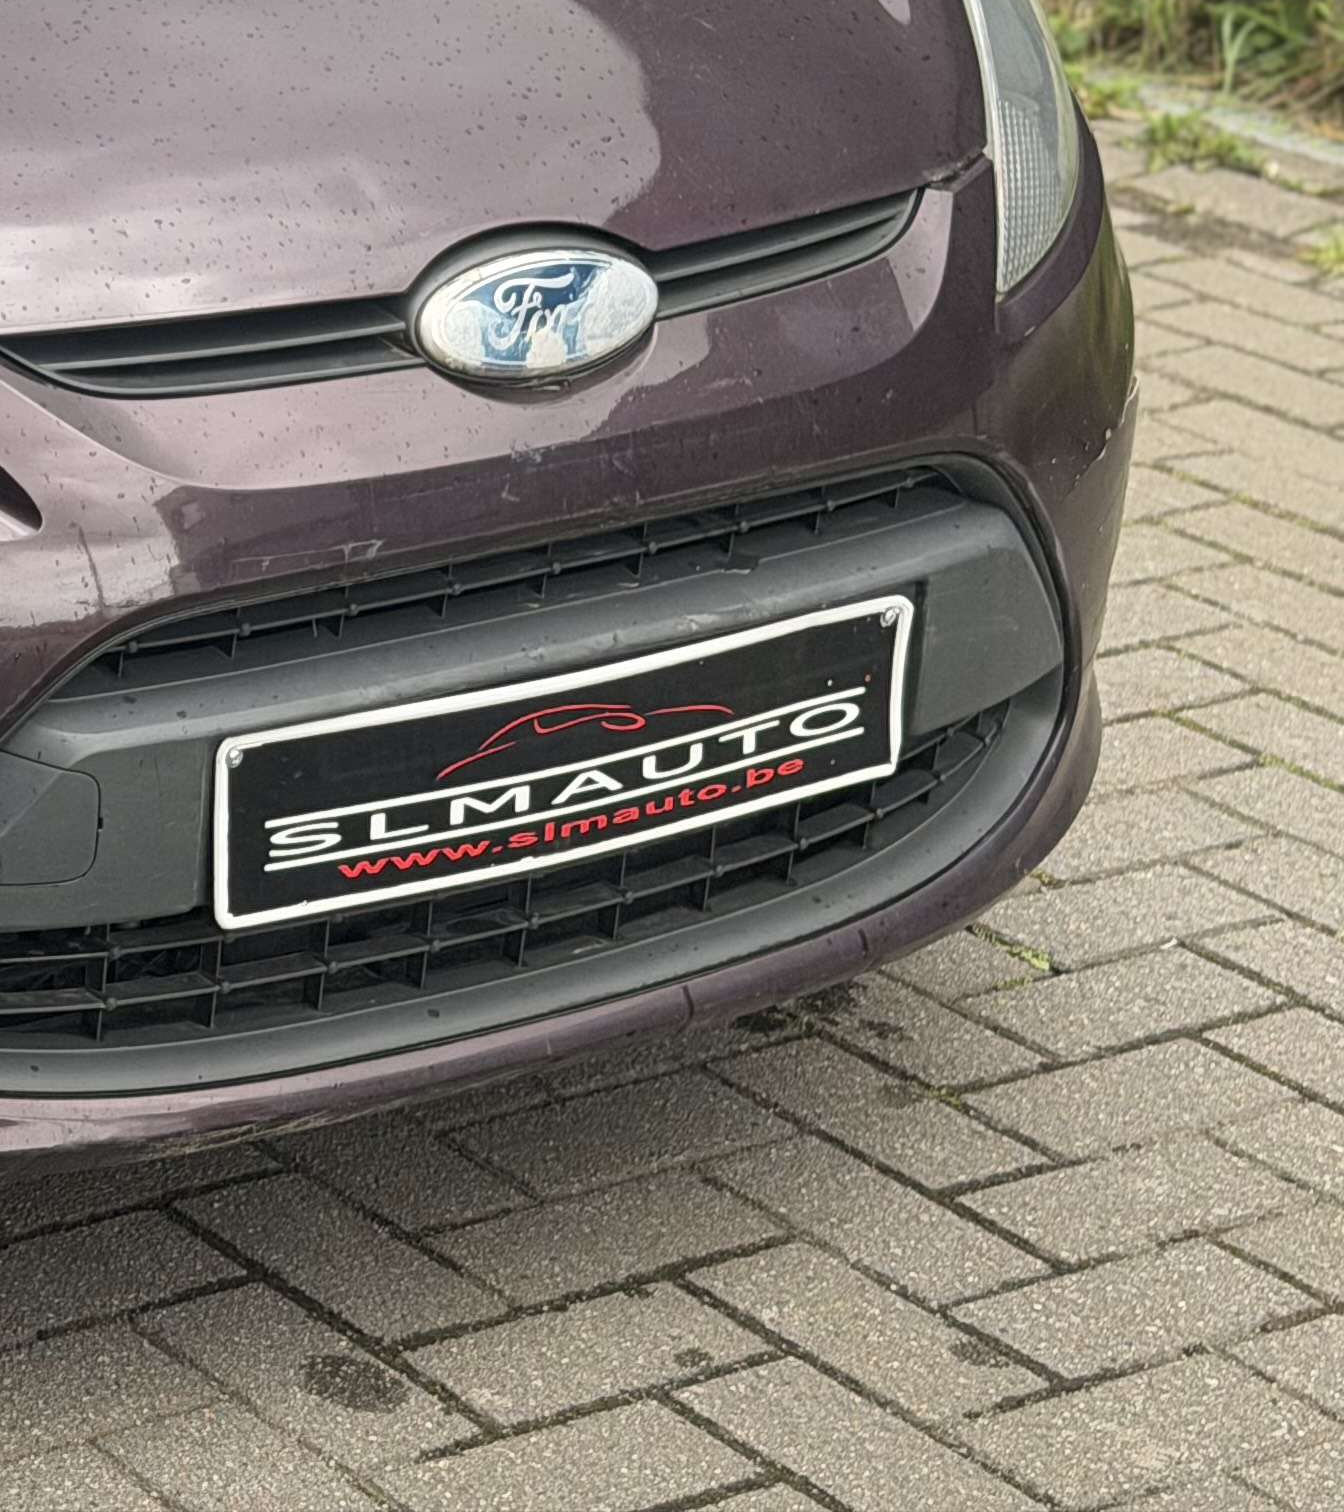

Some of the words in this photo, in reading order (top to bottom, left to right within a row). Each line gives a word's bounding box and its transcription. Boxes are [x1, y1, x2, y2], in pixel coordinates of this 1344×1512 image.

[486, 270, 582, 351] For
[267, 701, 861, 859] SLMAUTO
[336, 757, 807, 880] www.slmauto.be
